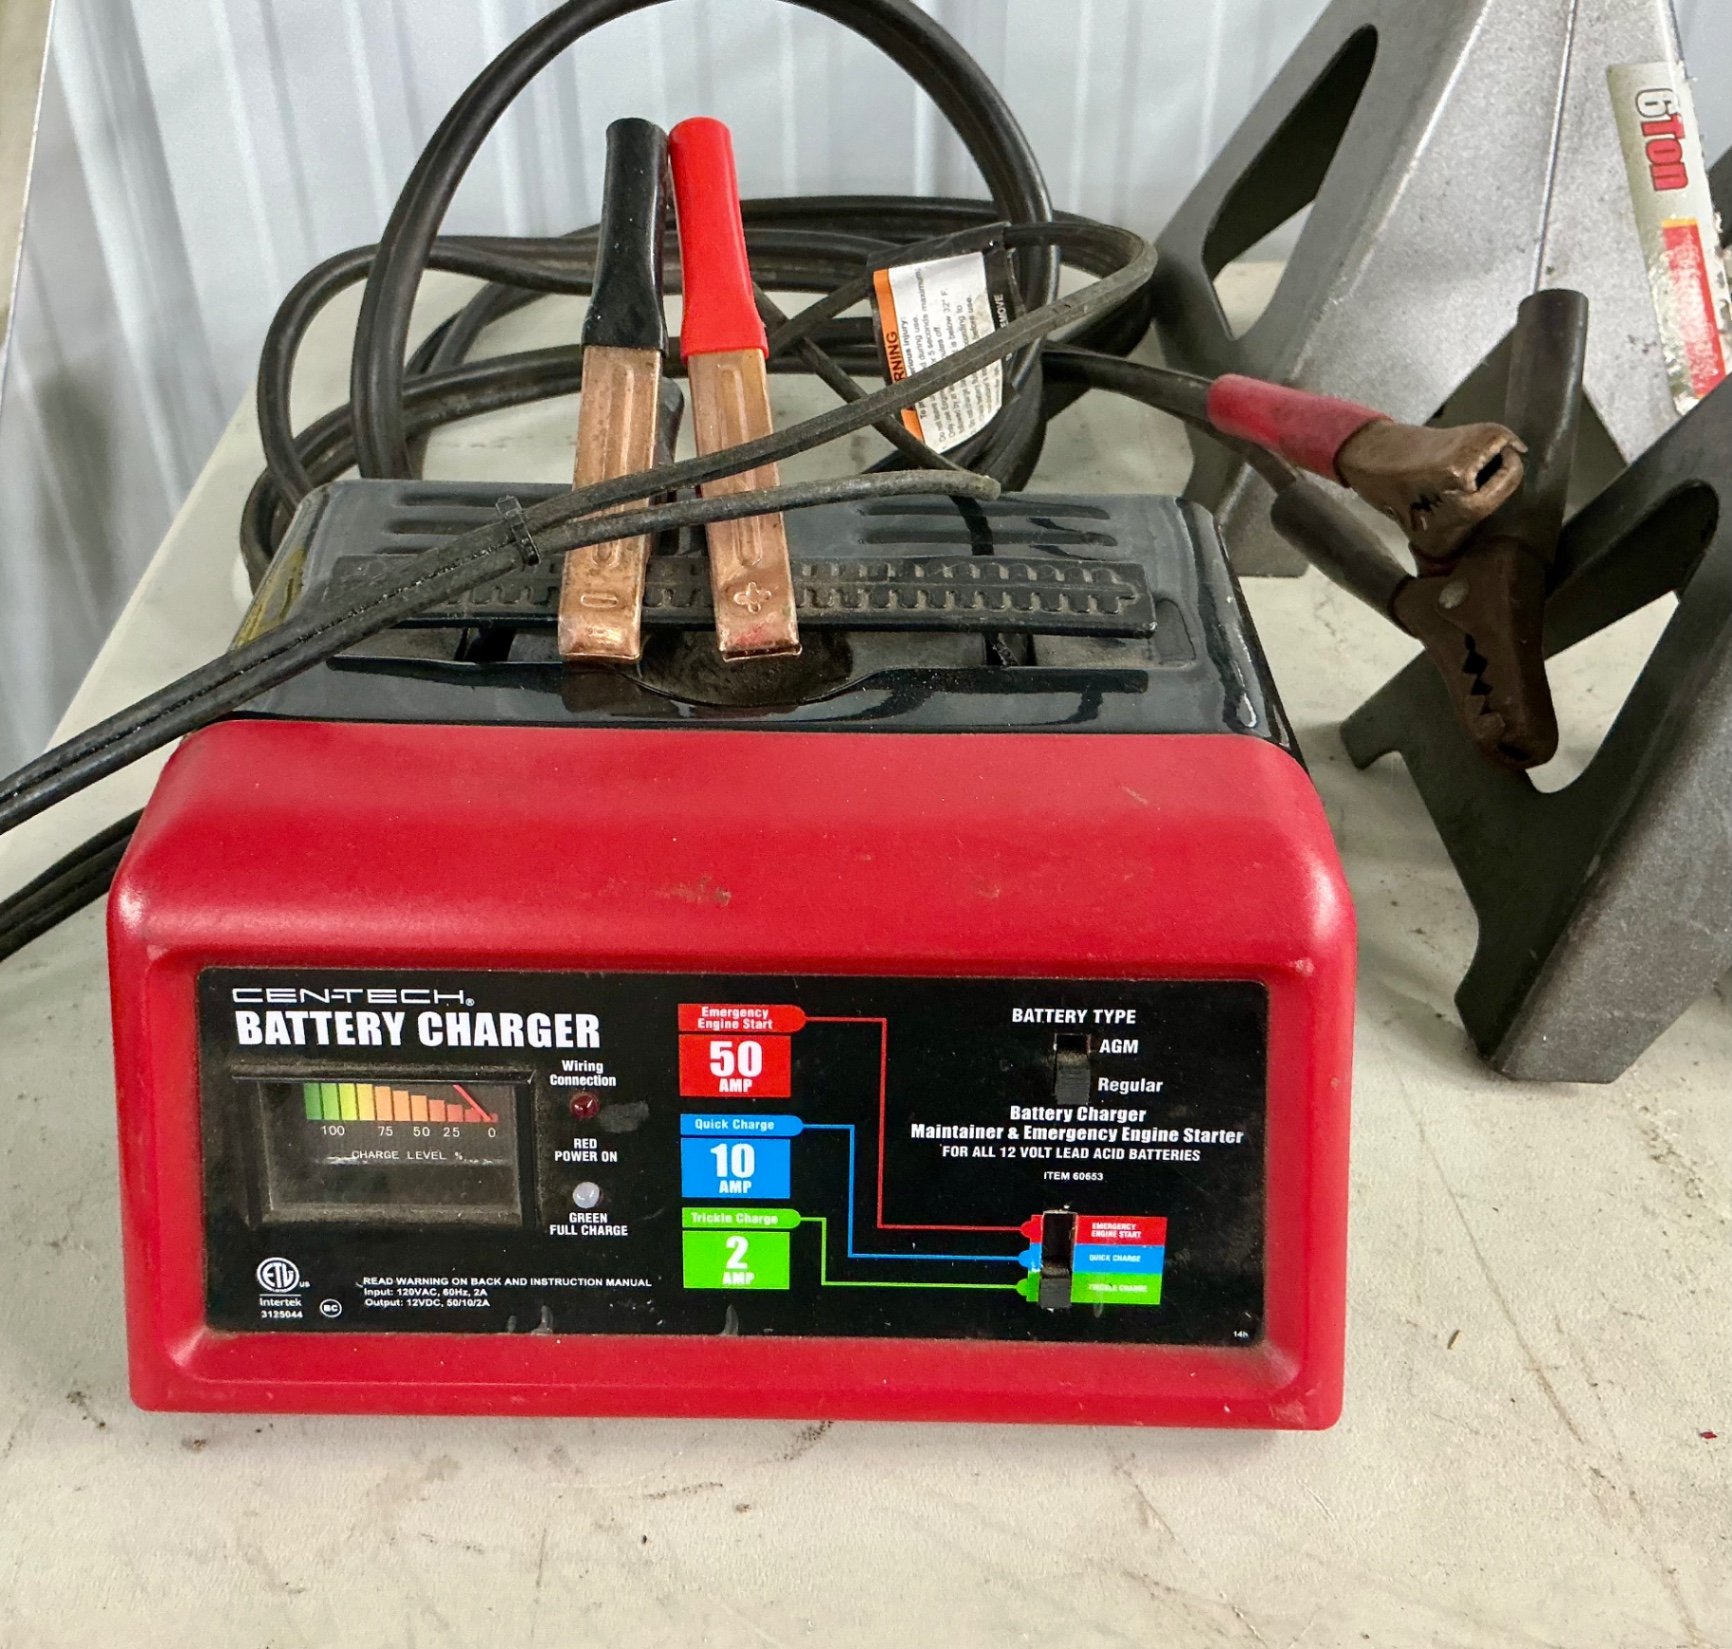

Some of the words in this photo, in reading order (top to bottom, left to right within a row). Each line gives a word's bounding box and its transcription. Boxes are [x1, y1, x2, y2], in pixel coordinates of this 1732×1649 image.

[993, 293, 1009, 328] EMOVE
[922, 314, 934, 349] seconds
[946, 315, 956, 340] below
[885, 331, 905, 382] RNING
[702, 1006, 768, 1020] Emergency
[1012, 1008, 1088, 1024] BATTERY
[1093, 1009, 1137, 1024] TYPE
[235, 1011, 405, 1046] BATTERY
[417, 1012, 600, 1048] CHARGER
[697, 1018, 740, 1031] Engine
[743, 1019, 773, 1030] Start
[1099, 1039, 1139, 1054] AGM
[709, 1040, 762, 1078] 50
[561, 1060, 604, 1074] Wiring
[549, 1074, 617, 1087] Connection
[719, 1079, 752, 1093] AMP
[1097, 1078, 1163, 1095] Regular
[1010, 1105, 1073, 1124] Battery
[1077, 1107, 1146, 1124] Charger
[695, 1118, 728, 1130] Quick
[732, 1119, 775, 1131] Charge
[321, 1125, 345, 1137] 100
[378, 1126, 393, 1137] 75
[413, 1126, 430, 1137] 50
[443, 1126, 460, 1138] 25
[487, 1127, 496, 1138] 0
[910, 1123, 1004, 1140] Maintainer
[1008, 1126, 1020, 1140] &
[1023, 1125, 1117, 1143] Emergency
[1121, 1127, 1179, 1144] Engine
[1183, 1128, 1245, 1144] Starter
[573, 1138, 598, 1149] RED
[351, 1151, 400, 1160] CHARGE
[407, 1151, 447, 1160] LEVEL
[554, 1151, 598, 1162] POWER
[601, 1151, 618, 1162] ON
[942, 1146, 968, 1158] FOR
[972, 1146, 996, 1158] ALL
[1000, 1147, 1016, 1158] 12
[1020, 1147, 1052, 1159] VOLT
[1055, 1148, 1089, 1159] LEAD
[1093, 1149, 1125, 1160] ACID
[1129, 1149, 1201, 1161] BATTERIES
[710, 1143, 755, 1178] 10
[1044, 1171, 1070, 1181] ITEM
[1073, 1172, 1104, 1181] 60653
[719, 1180, 752, 1194] AMP
[568, 1212, 608, 1224] GREEN
[690, 1212, 733, 1224] Trickle
[736, 1212, 779, 1225] Charge
[549, 1225, 577, 1236] FULL
[579, 1225, 629, 1237] CHARGE
[1091, 1222, 1137, 1230] EMERGENCY
[1091, 1230, 1118, 1238] ENGINE
[725, 1235, 749, 1269] 2
[1089, 1254, 1111, 1262] QUICK
[1112, 1254, 1141, 1263] CHARGE
[363, 1276, 394, 1286] READ
[396, 1277, 449, 1286] WARNING
[451, 1277, 468, 1286] ON
[470, 1277, 502, 1286] BACK
[504, 1277, 528, 1286] AND
[530, 1277, 603, 1286] INSTRUCTION
[605, 1278, 653, 1287] MANUAL
[722, 1272, 755, 1286] AMP
[363, 1288, 394, 1297] Input:
[397, 1288, 440, 1297] 120VAC,
[442, 1288, 471, 1297] 60Hz,
[473, 1288, 488, 1297] 2A
[259, 1297, 302, 1307] Intertek
[364, 1298, 404, 1309] Output:
[406, 1299, 444, 1308] 12VDC,
[446, 1298, 491, 1307] 50/10/2A
[261, 1310, 304, 1319] 3125044
